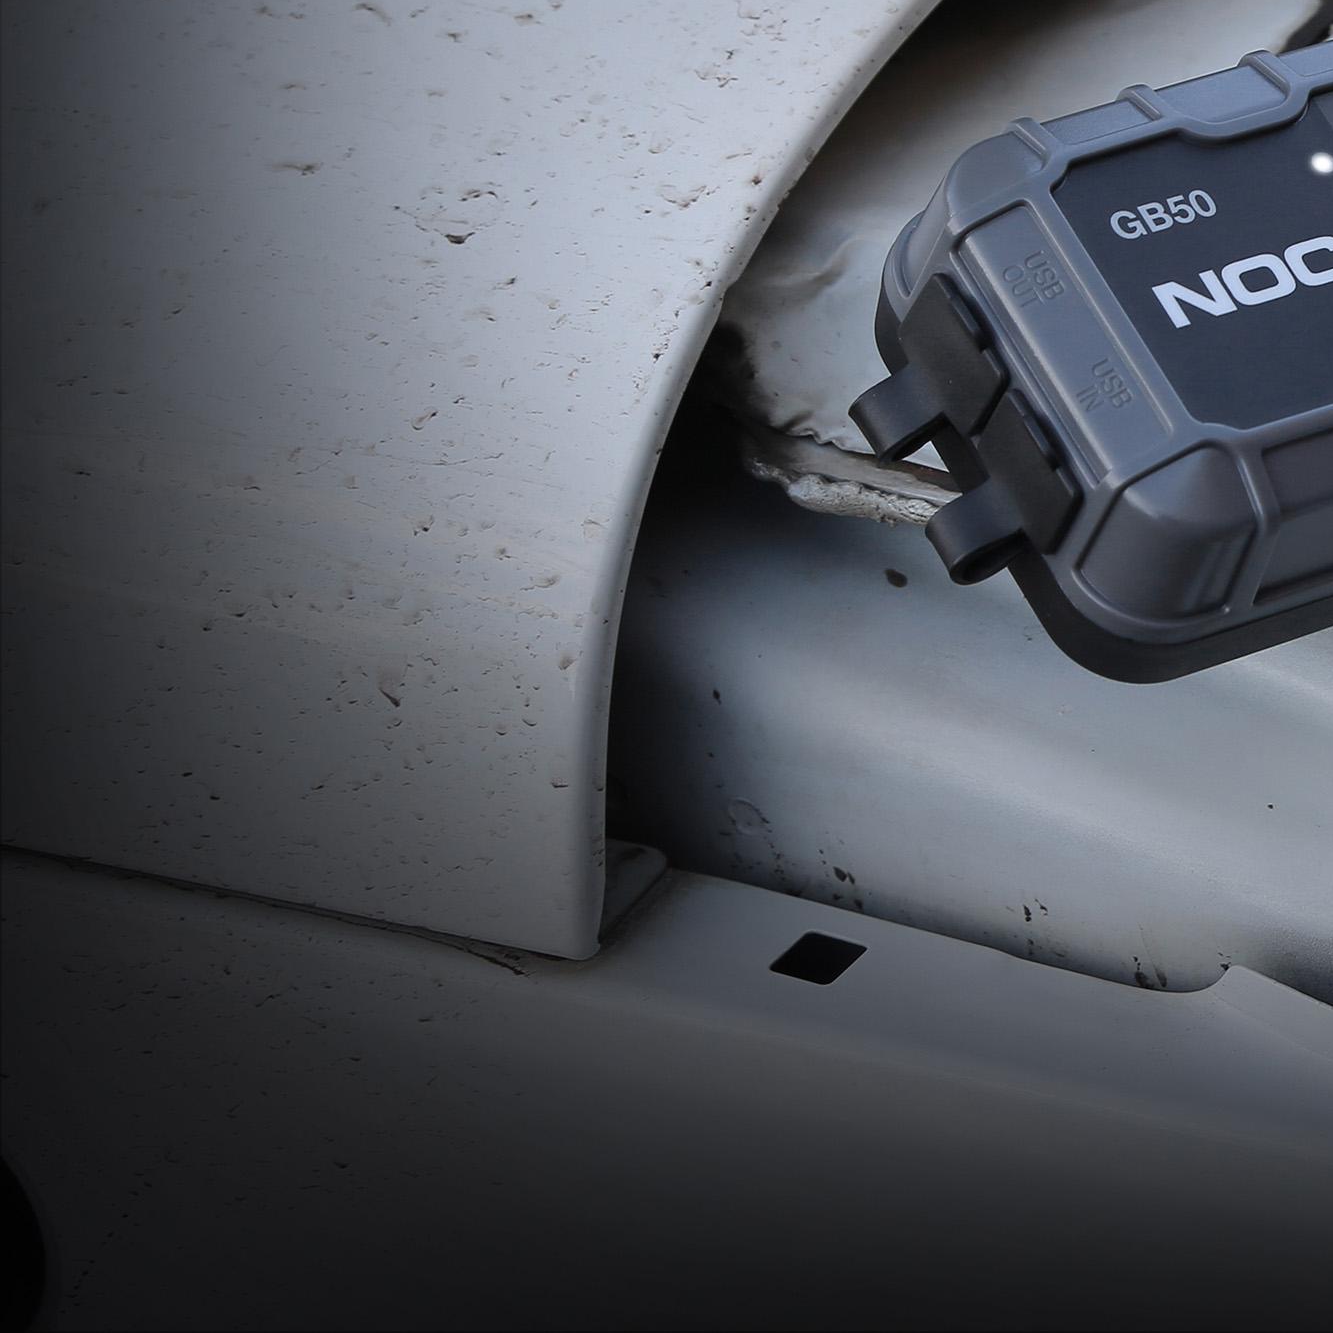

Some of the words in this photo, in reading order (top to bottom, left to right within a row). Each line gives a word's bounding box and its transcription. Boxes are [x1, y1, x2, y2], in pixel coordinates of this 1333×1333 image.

[1109, 189, 1217, 240] GB50
[1002, 265, 1046, 308] OUT
[1023, 249, 1066, 300] USB
[1076, 384, 1104, 412] IN
[1091, 358, 1133, 408] USB
